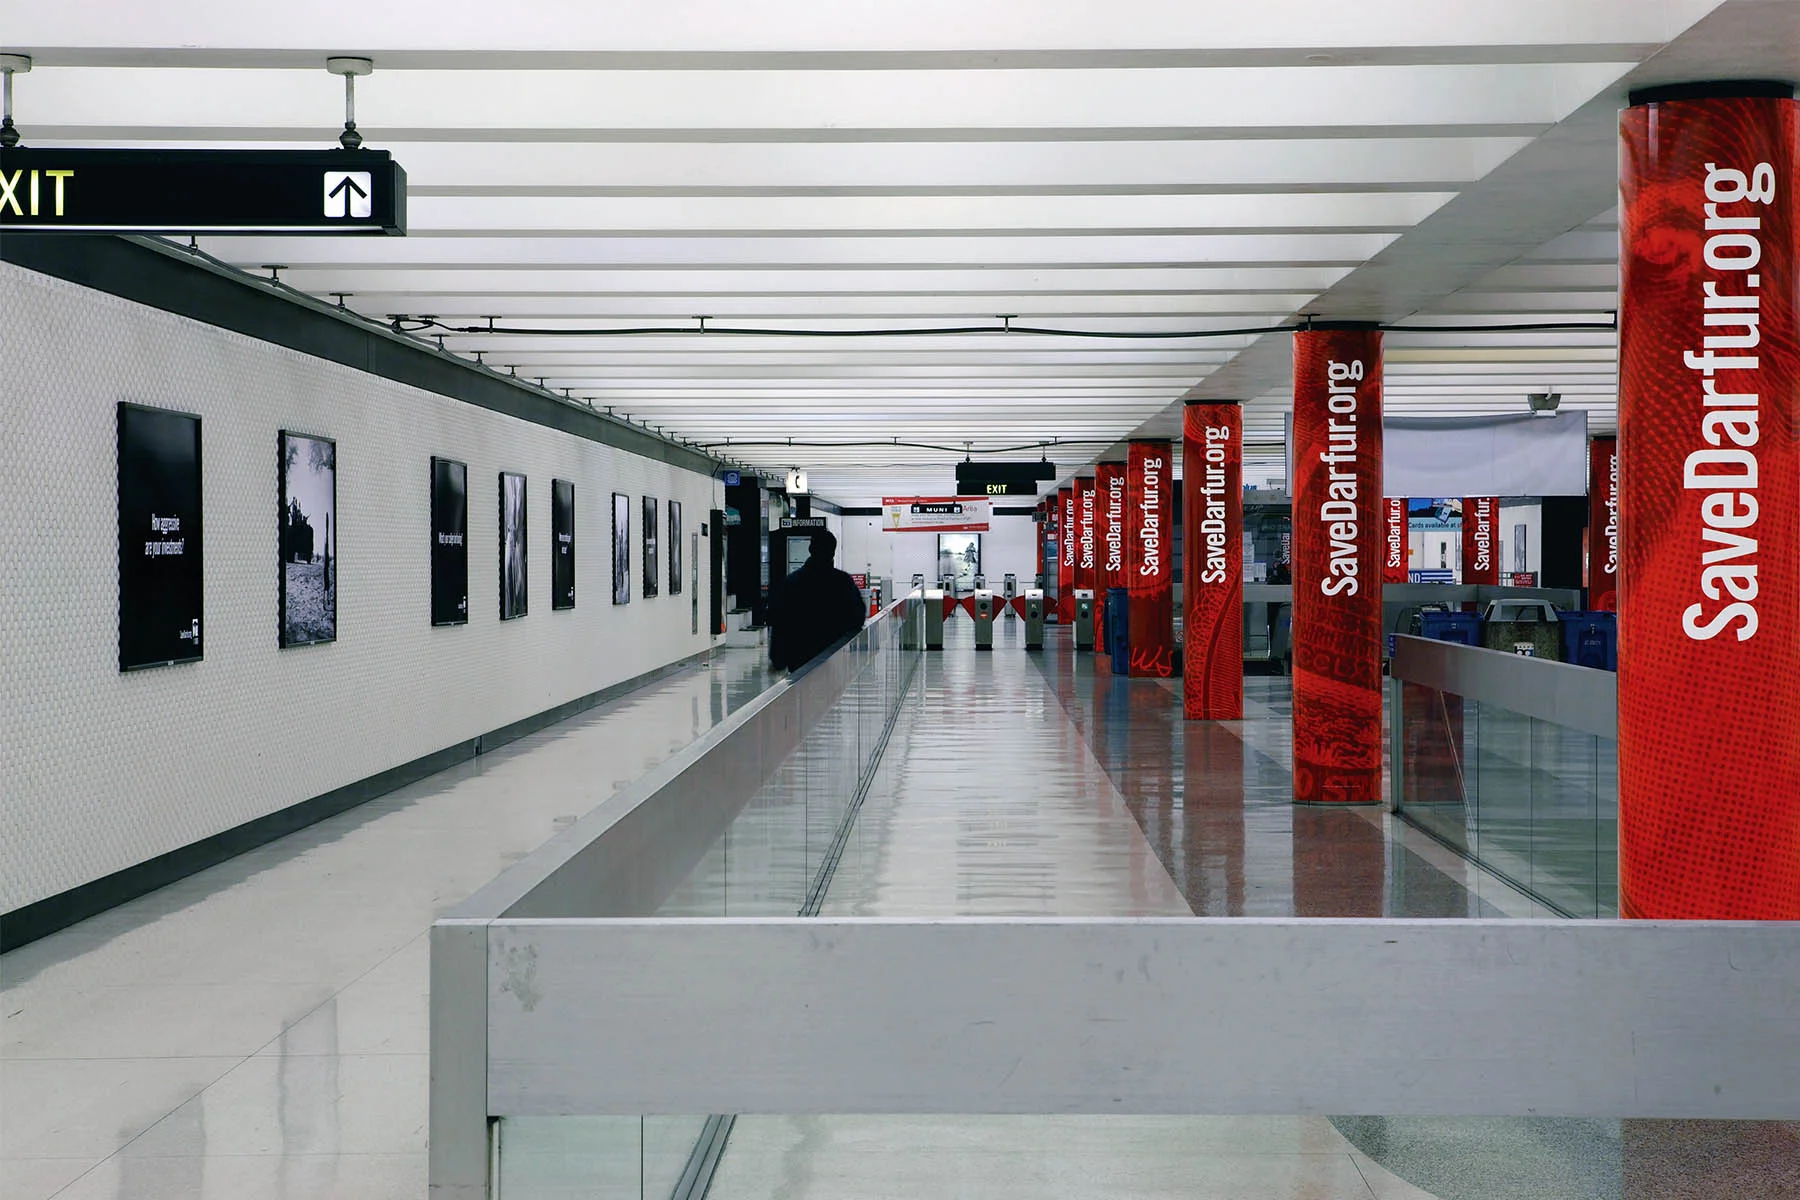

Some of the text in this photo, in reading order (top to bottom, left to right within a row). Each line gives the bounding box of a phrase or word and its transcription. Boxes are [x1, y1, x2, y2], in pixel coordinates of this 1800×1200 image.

[1683, 162, 1776, 642] SaveDarfur.org
[792, 519, 825, 527] INFORMATION
[986, 484, 1007, 494] EXIT
[1106, 477, 1124, 572] SaveDarfur.org
[1140, 457, 1162, 576] SaveDarfur.org
[1201, 425, 1230, 585] SaveDarfur.org
[1320, 359, 1364, 597] SaveDarfur.org
[1080, 490, 1096, 569] SaveDarfur.org
[1388, 497, 1401, 568] SaveDarfur.o
